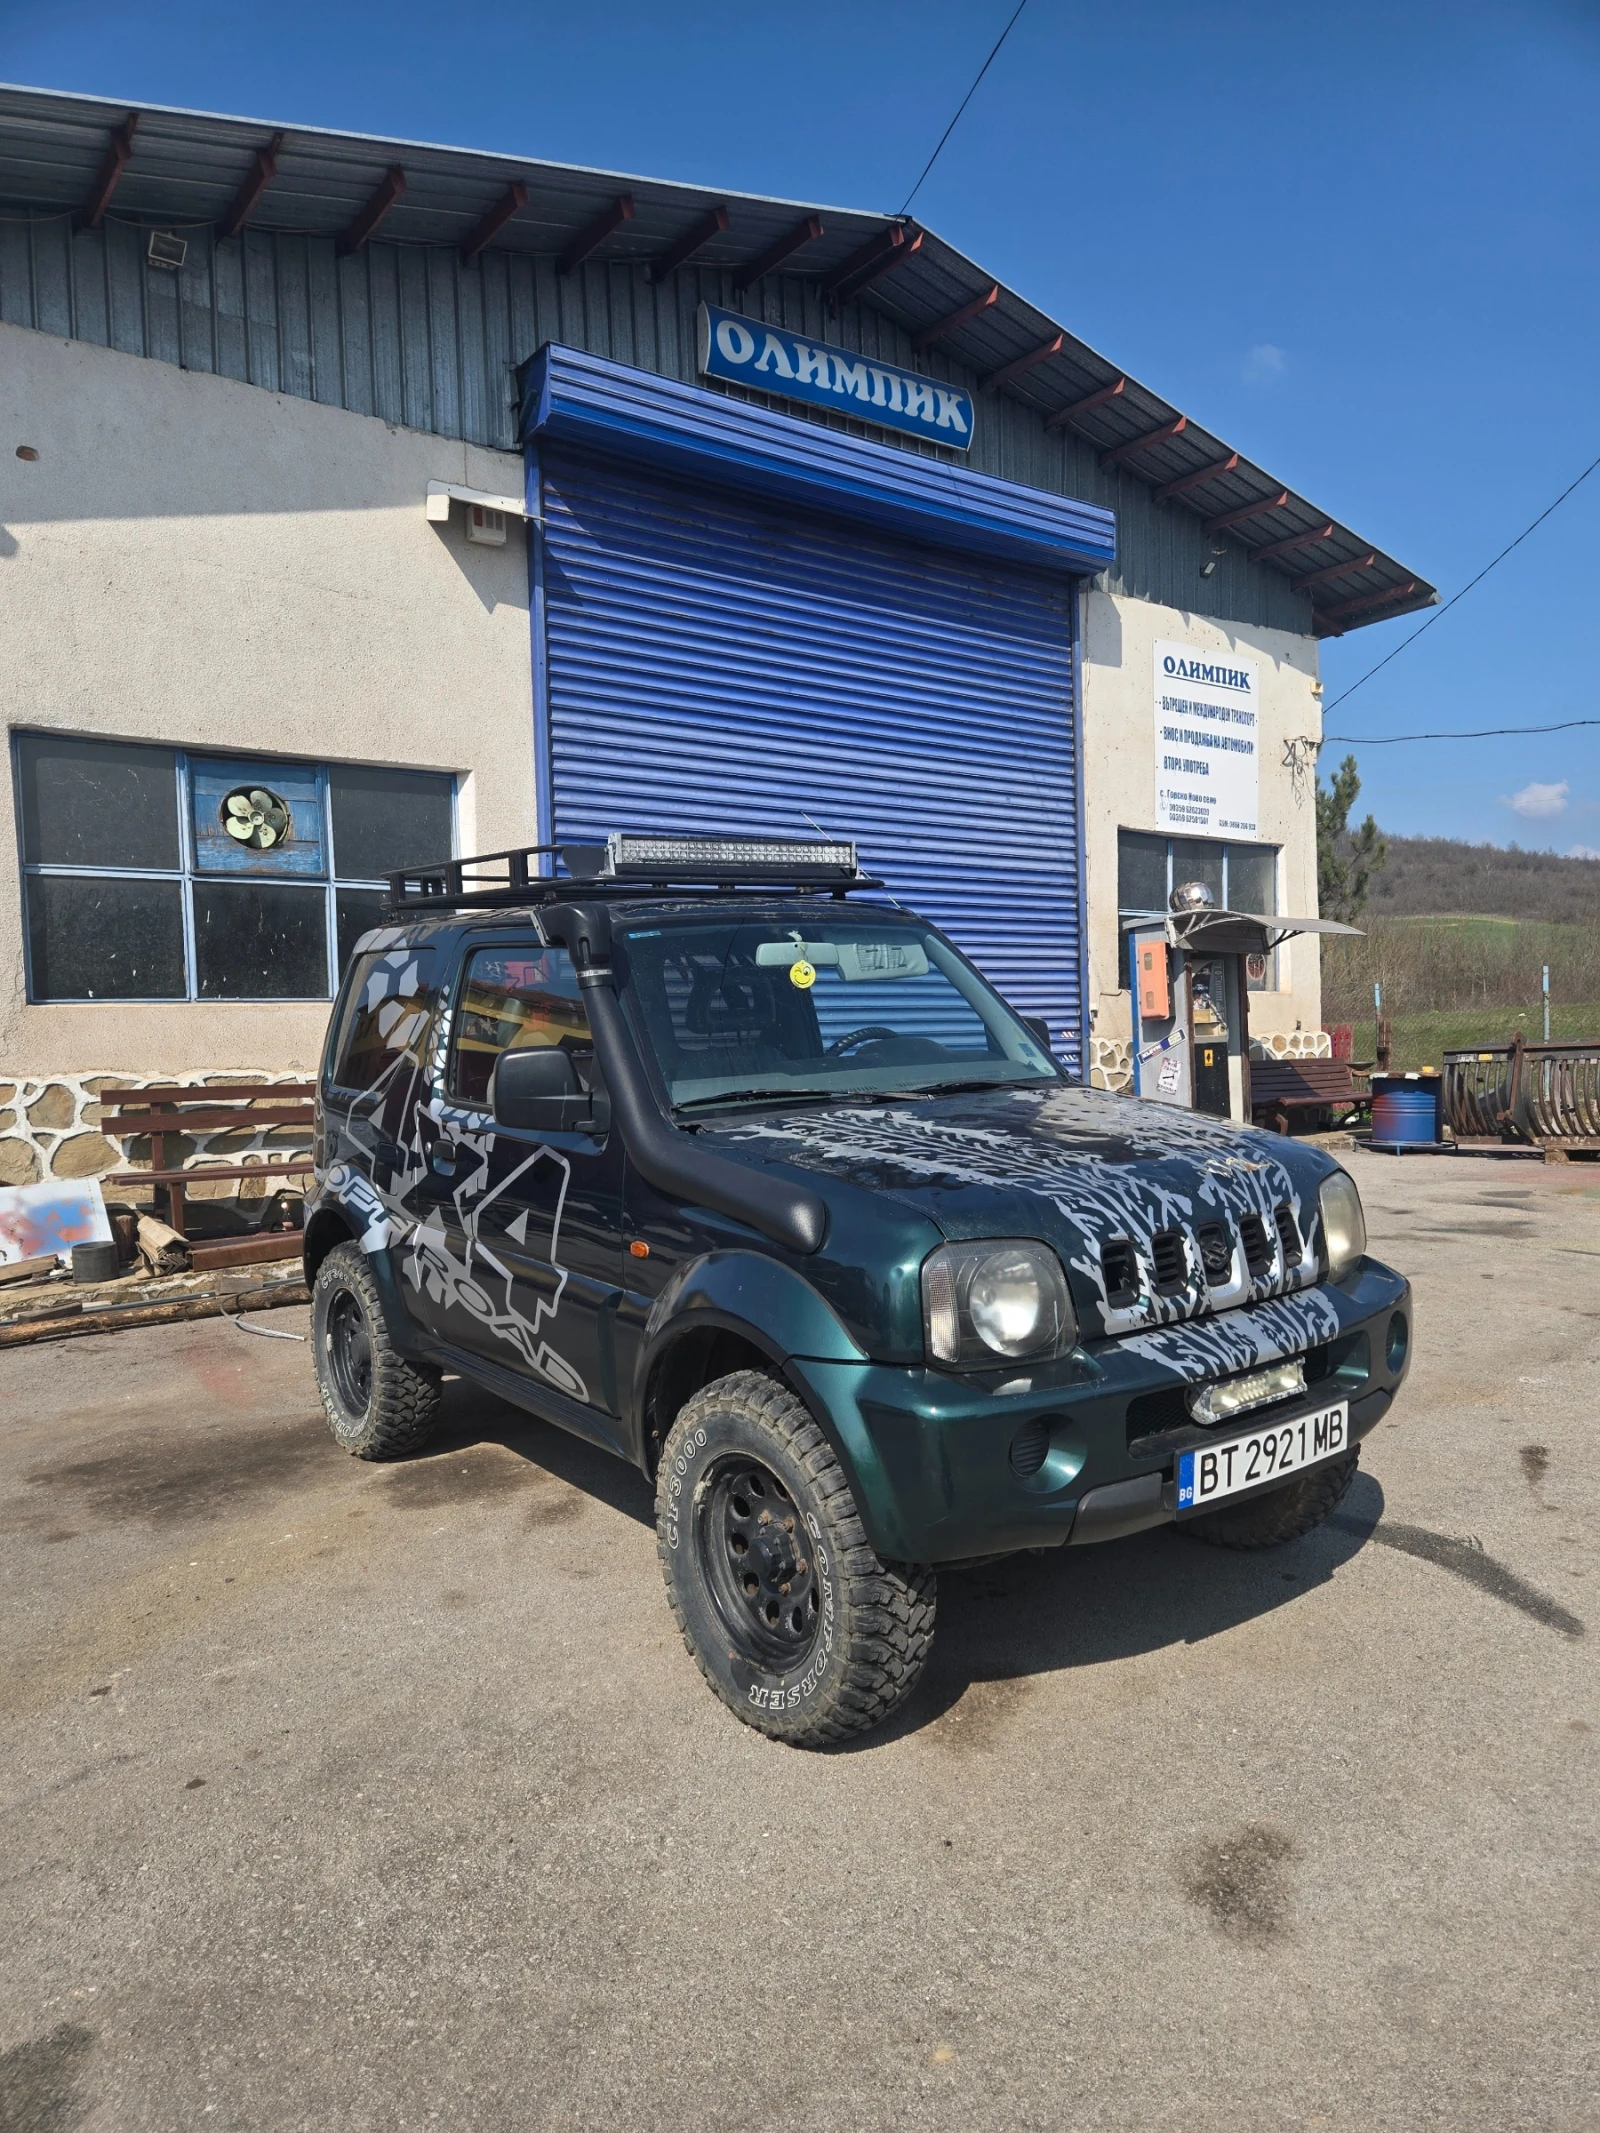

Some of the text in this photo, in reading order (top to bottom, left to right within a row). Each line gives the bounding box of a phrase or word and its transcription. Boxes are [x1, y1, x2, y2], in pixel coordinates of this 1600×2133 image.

[716, 320, 968, 433] ОЛИМПИК
[1163, 655, 1251, 690] ОЛИМПИК
[1163, 725, 1179, 742] ВНОС
[1213, 734, 1221, 749] НА
[1163, 755, 1210, 776] ВТОРА УПОТРЕБА
[1200, 1408, 1344, 1497] BT 2921 MB
[666, 1428, 707, 1550] CF3000
[1178, 1486, 1193, 1503] BG
[747, 1511, 835, 1711] COMFORSER
